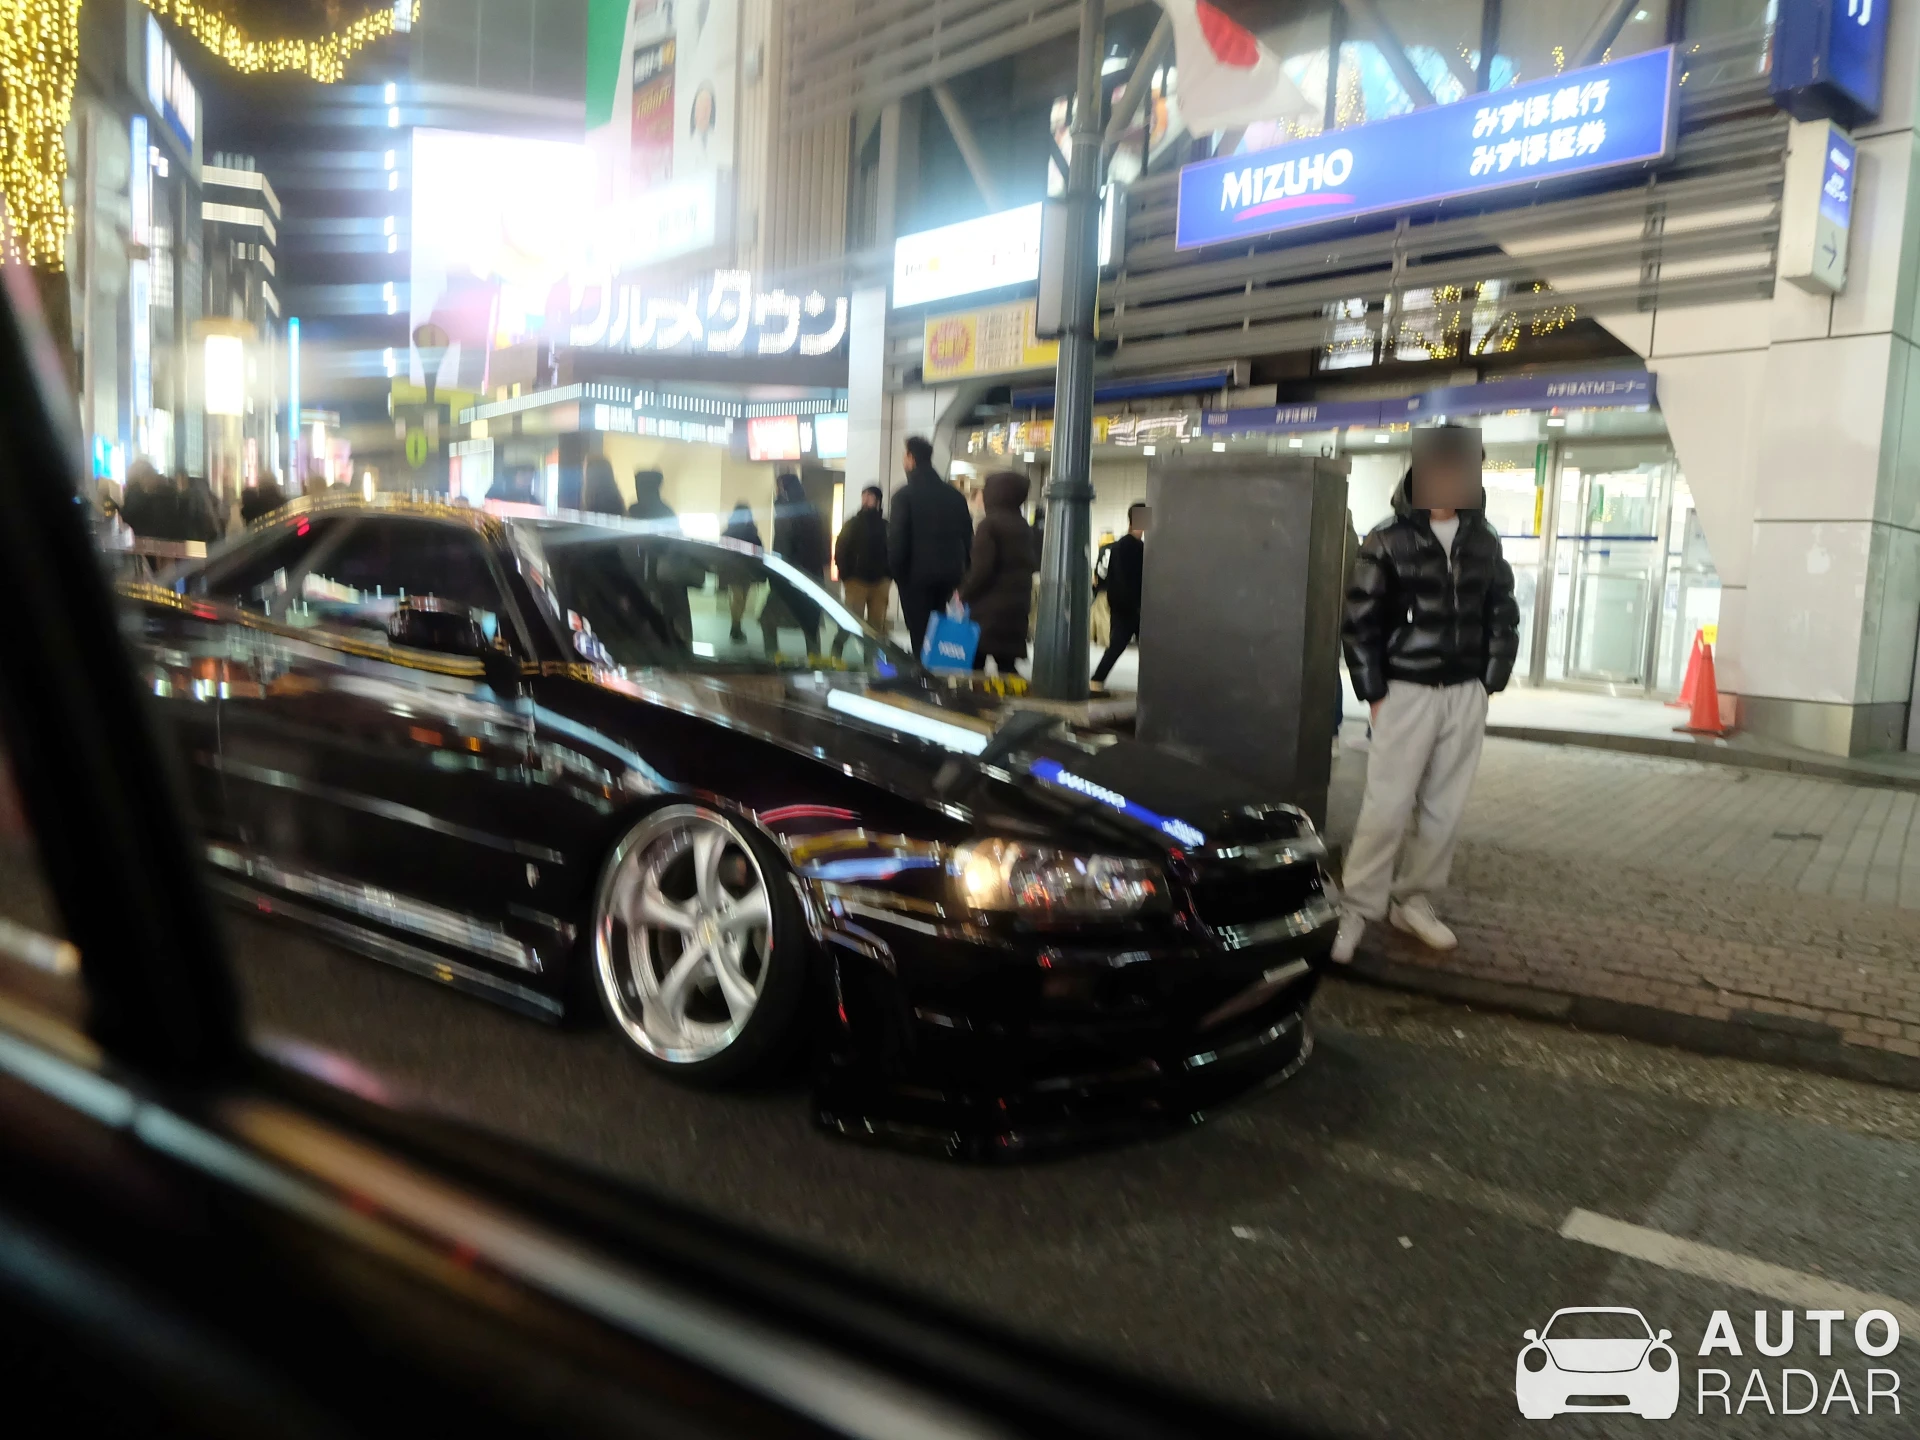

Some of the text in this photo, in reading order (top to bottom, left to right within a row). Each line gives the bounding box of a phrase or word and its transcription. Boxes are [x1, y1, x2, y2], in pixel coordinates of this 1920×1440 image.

[1472, 79, 1610, 139] みずほ銀行
[1469, 119, 1607, 177] みずほ証券
[1220, 148, 1354, 212] MIZUHO
